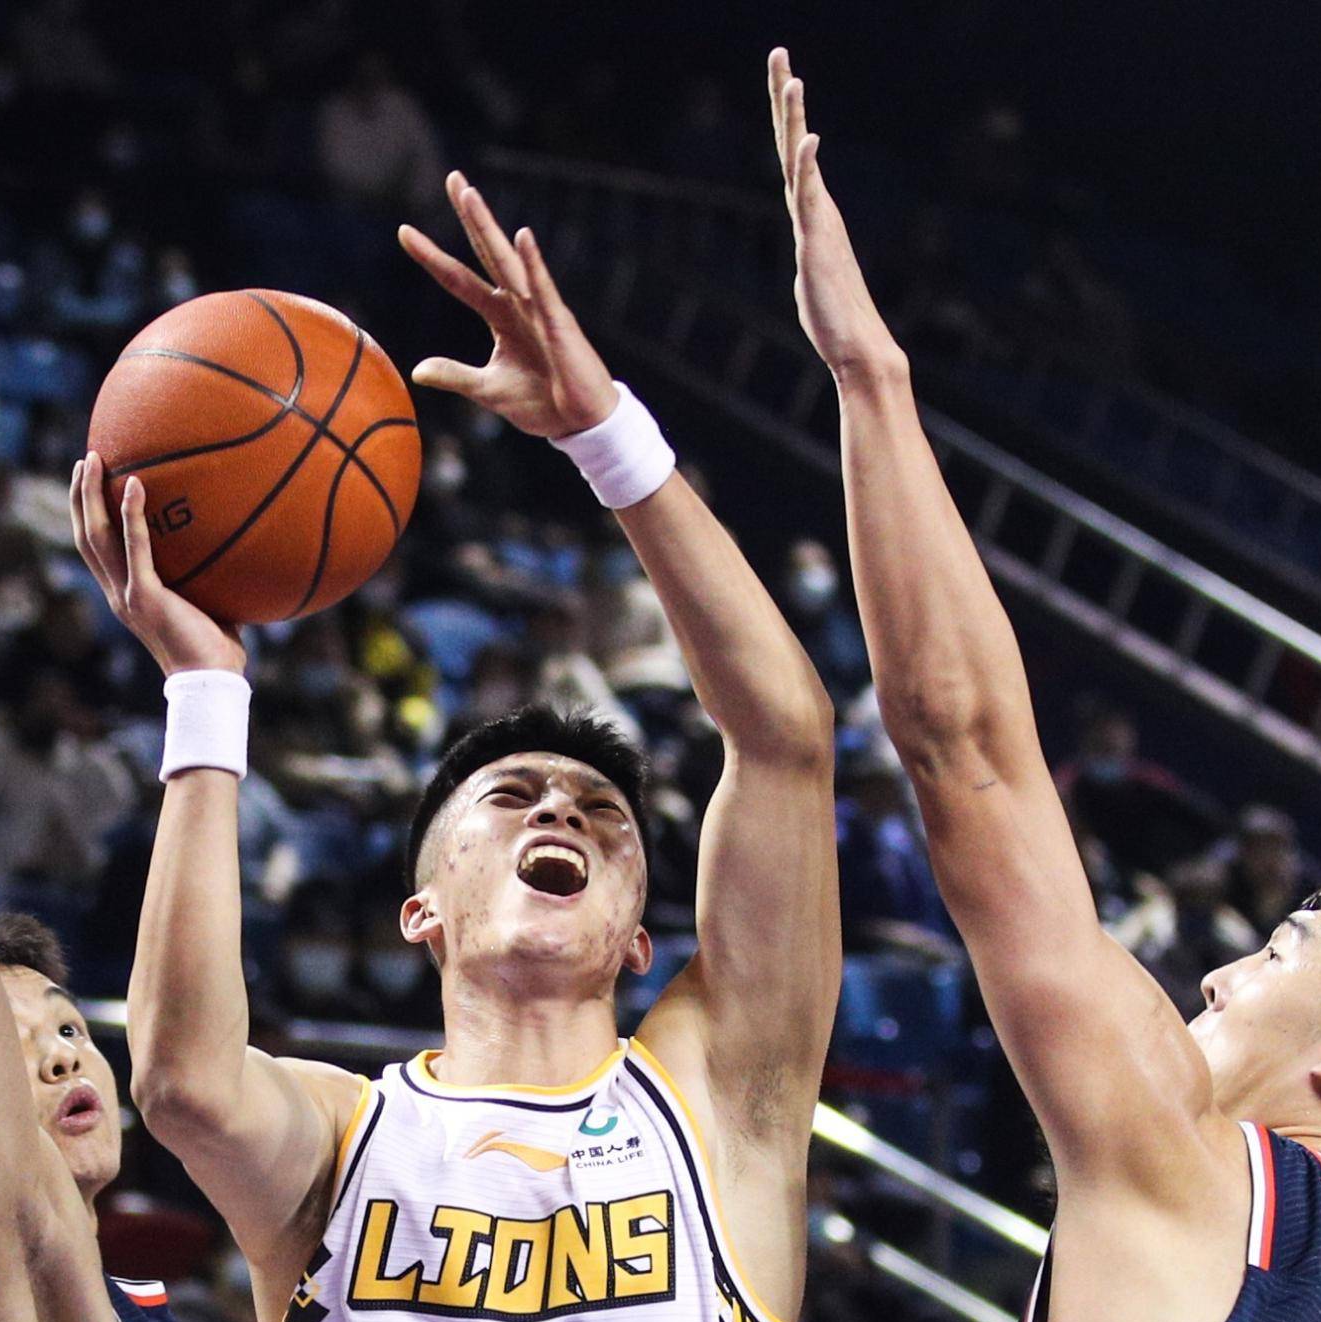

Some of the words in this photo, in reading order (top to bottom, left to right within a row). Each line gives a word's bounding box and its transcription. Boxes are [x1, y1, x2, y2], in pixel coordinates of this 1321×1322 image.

[570, 1135, 641, 1161] 中国人寿
[575, 1159, 614, 1169] CHINA
[617, 1149, 645, 1164] LIFE
